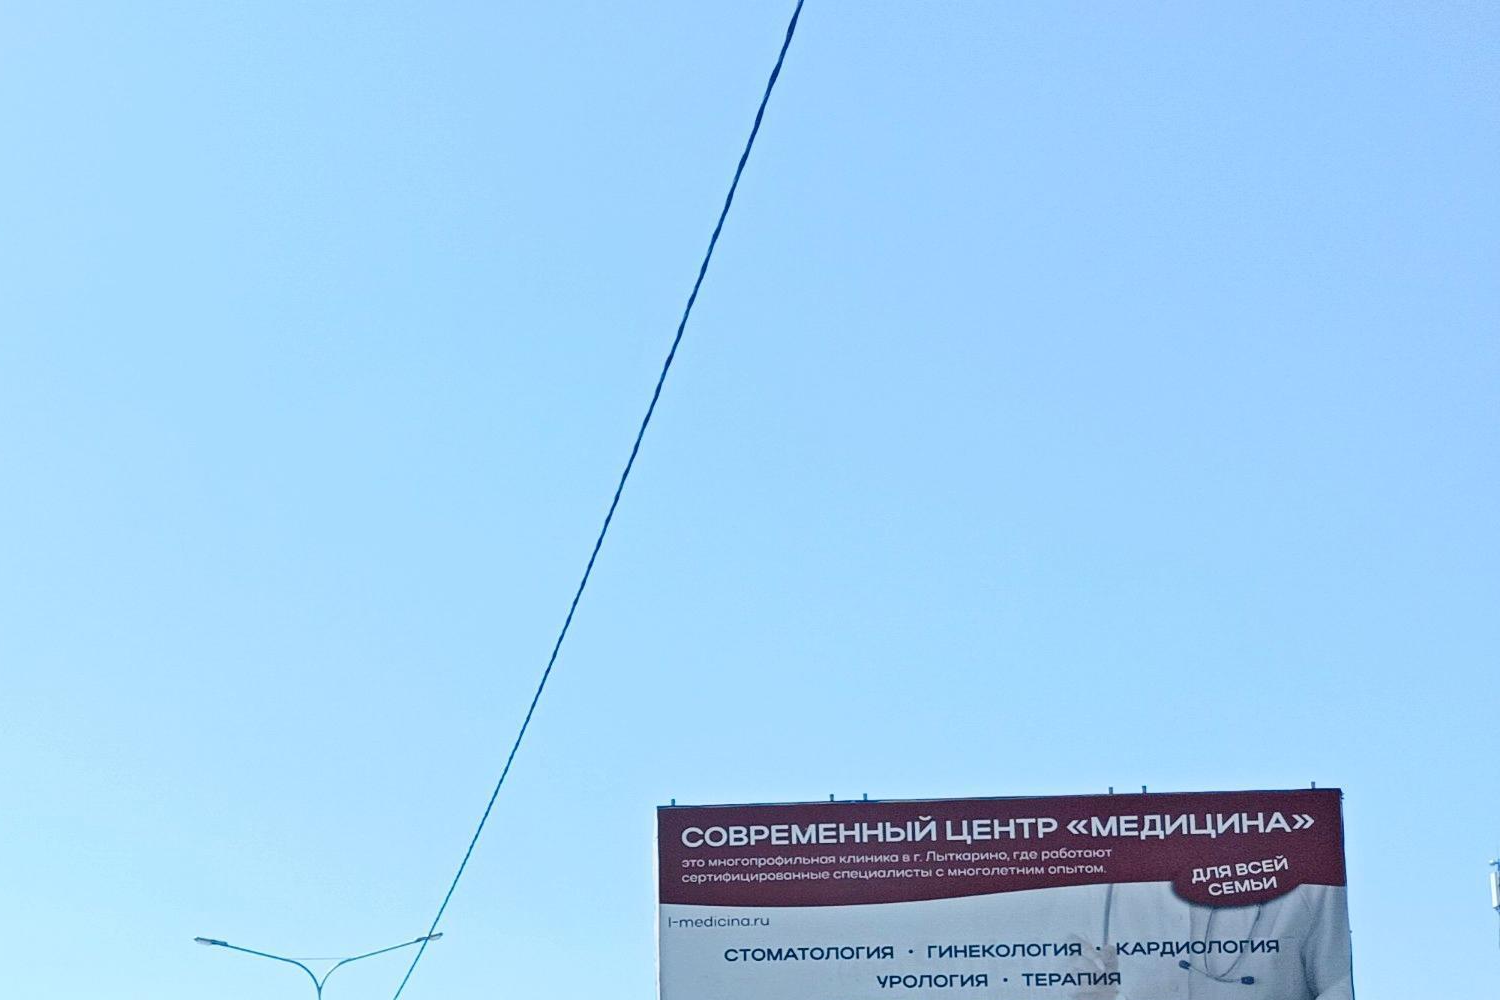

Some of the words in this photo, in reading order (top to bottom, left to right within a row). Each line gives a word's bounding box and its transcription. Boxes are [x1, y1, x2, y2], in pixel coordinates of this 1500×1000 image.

[681, 815, 937, 848] СОВРЕМЕННЫЙ
[945, 818, 1058, 845] ЦЕНТР
[1066, 811, 1315, 840] «МЕДИЦИНА»
[681, 858, 706, 869] это
[708, 854, 836, 870] многопрофильная
[839, 852, 899, 866] клиника
[902, 855, 910, 863] в
[913, 854, 923, 863] г.
[925, 849, 1010, 864] Лыткарино,
[1013, 849, 1038, 861] где
[1041, 847, 1113, 861] работают
[1191, 864, 1232, 884] ДЛЯ
[1235, 855, 1289, 877] ВСЕЙ
[681, 870, 831, 884] сертифицированные
[833, 867, 933, 880] специалисты
[935, 869, 945, 877] с
[947, 865, 1045, 877] многолетним
[1047, 864, 1107, 876] опытом.
[1208, 875, 1277, 897] СЕМЬИ
[723, 945, 895, 963] СТОМАТОЛОГИЯ
[927, 942, 1082, 959] ГИНЕКОЛОГИЯ
[1115, 939, 1280, 957] КАРДИОЛОГИЯ
[876, 973, 989, 989] УРОЛОГИЯ
[1021, 971, 1122, 987] ТЕРАПИЯ
